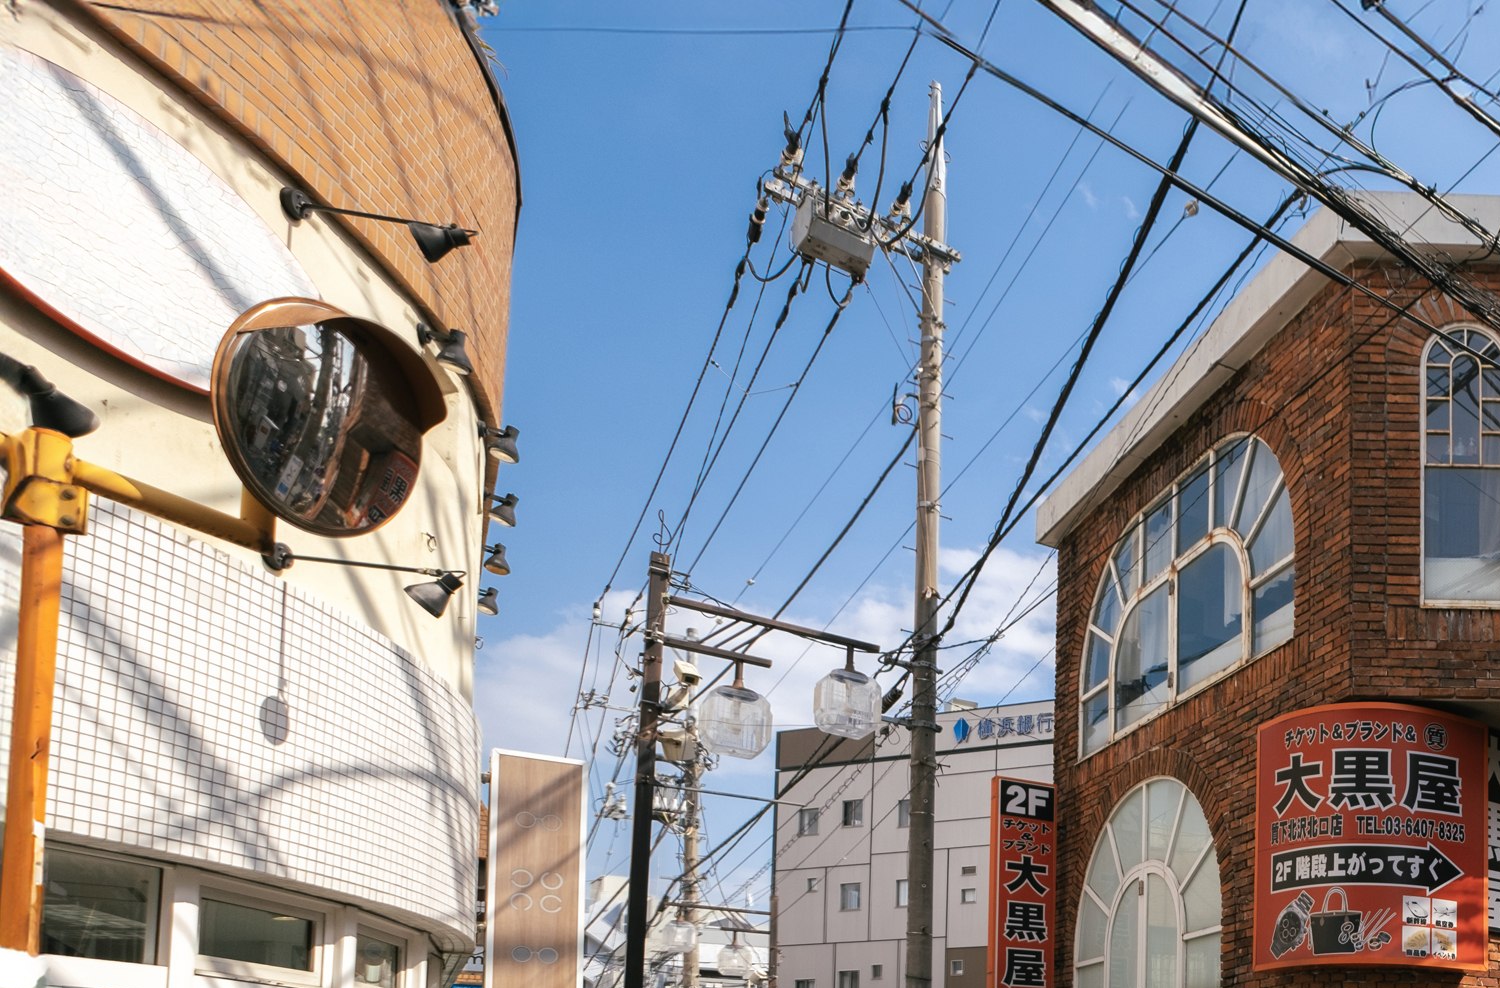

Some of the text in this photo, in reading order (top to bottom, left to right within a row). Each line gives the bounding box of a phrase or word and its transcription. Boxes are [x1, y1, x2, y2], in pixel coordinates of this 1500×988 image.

[978, 714, 1053, 739] 横浜銀行
[1425, 725, 1446, 750] 質
[1273, 748, 1463, 818] 大黒屋
[1006, 784, 1050, 816] 2F
[1003, 818, 1052, 835] チケット
[1021, 832, 1034, 842] &
[1270, 813, 1466, 845] 質下北沢北口店 TEL:03-6407-8325
[1003, 838, 1051, 855] ブランド
[1275, 851, 1444, 883] 2F 階段上がってすぐ
[1001, 854, 1050, 988] 大黒屋
